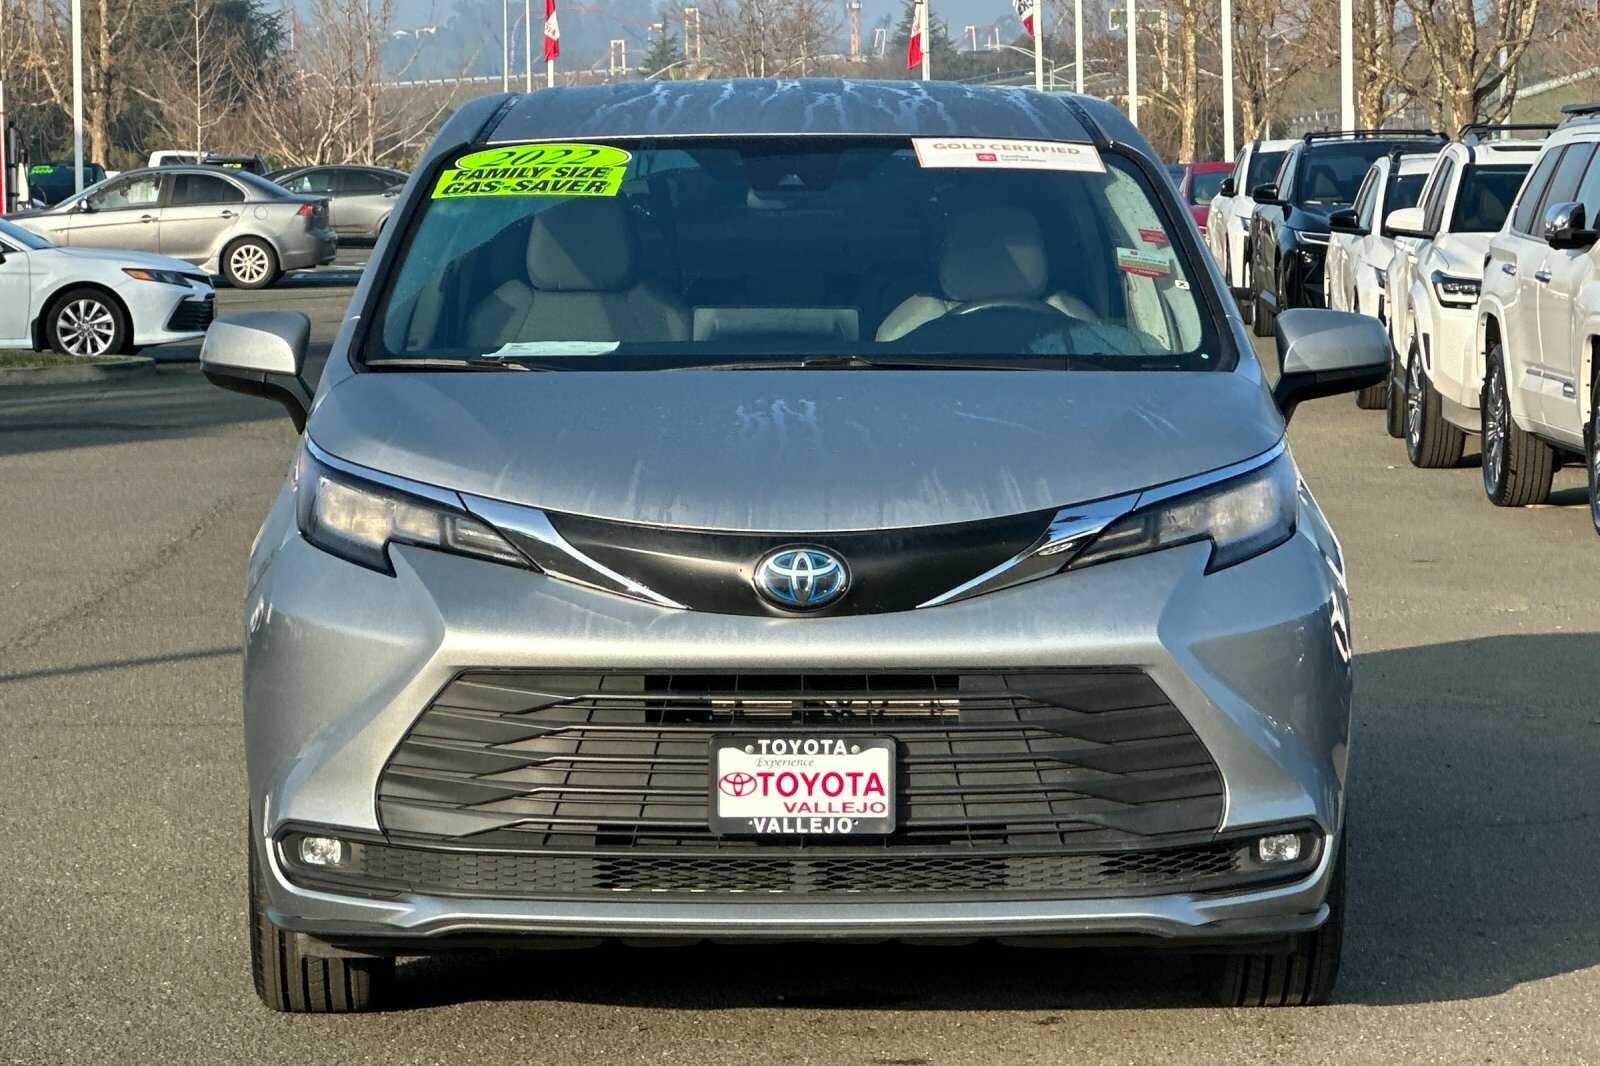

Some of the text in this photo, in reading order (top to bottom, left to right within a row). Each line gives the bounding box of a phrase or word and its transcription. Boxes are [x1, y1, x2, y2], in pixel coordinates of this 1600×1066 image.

[933, 142, 1081, 155] GOLD CERTIFIED
[483, 149, 600, 166] 2022
[453, 166, 611, 179] FAMILY SIZE
[442, 180, 609, 194] GAS-SAVER
[757, 739, 847, 756] TOYOTA
[755, 757, 815, 769] Experience
[756, 772, 886, 797] TOYOTA
[783, 801, 886, 814] VALLEJO
[752, 817, 853, 834] VALLEJO
